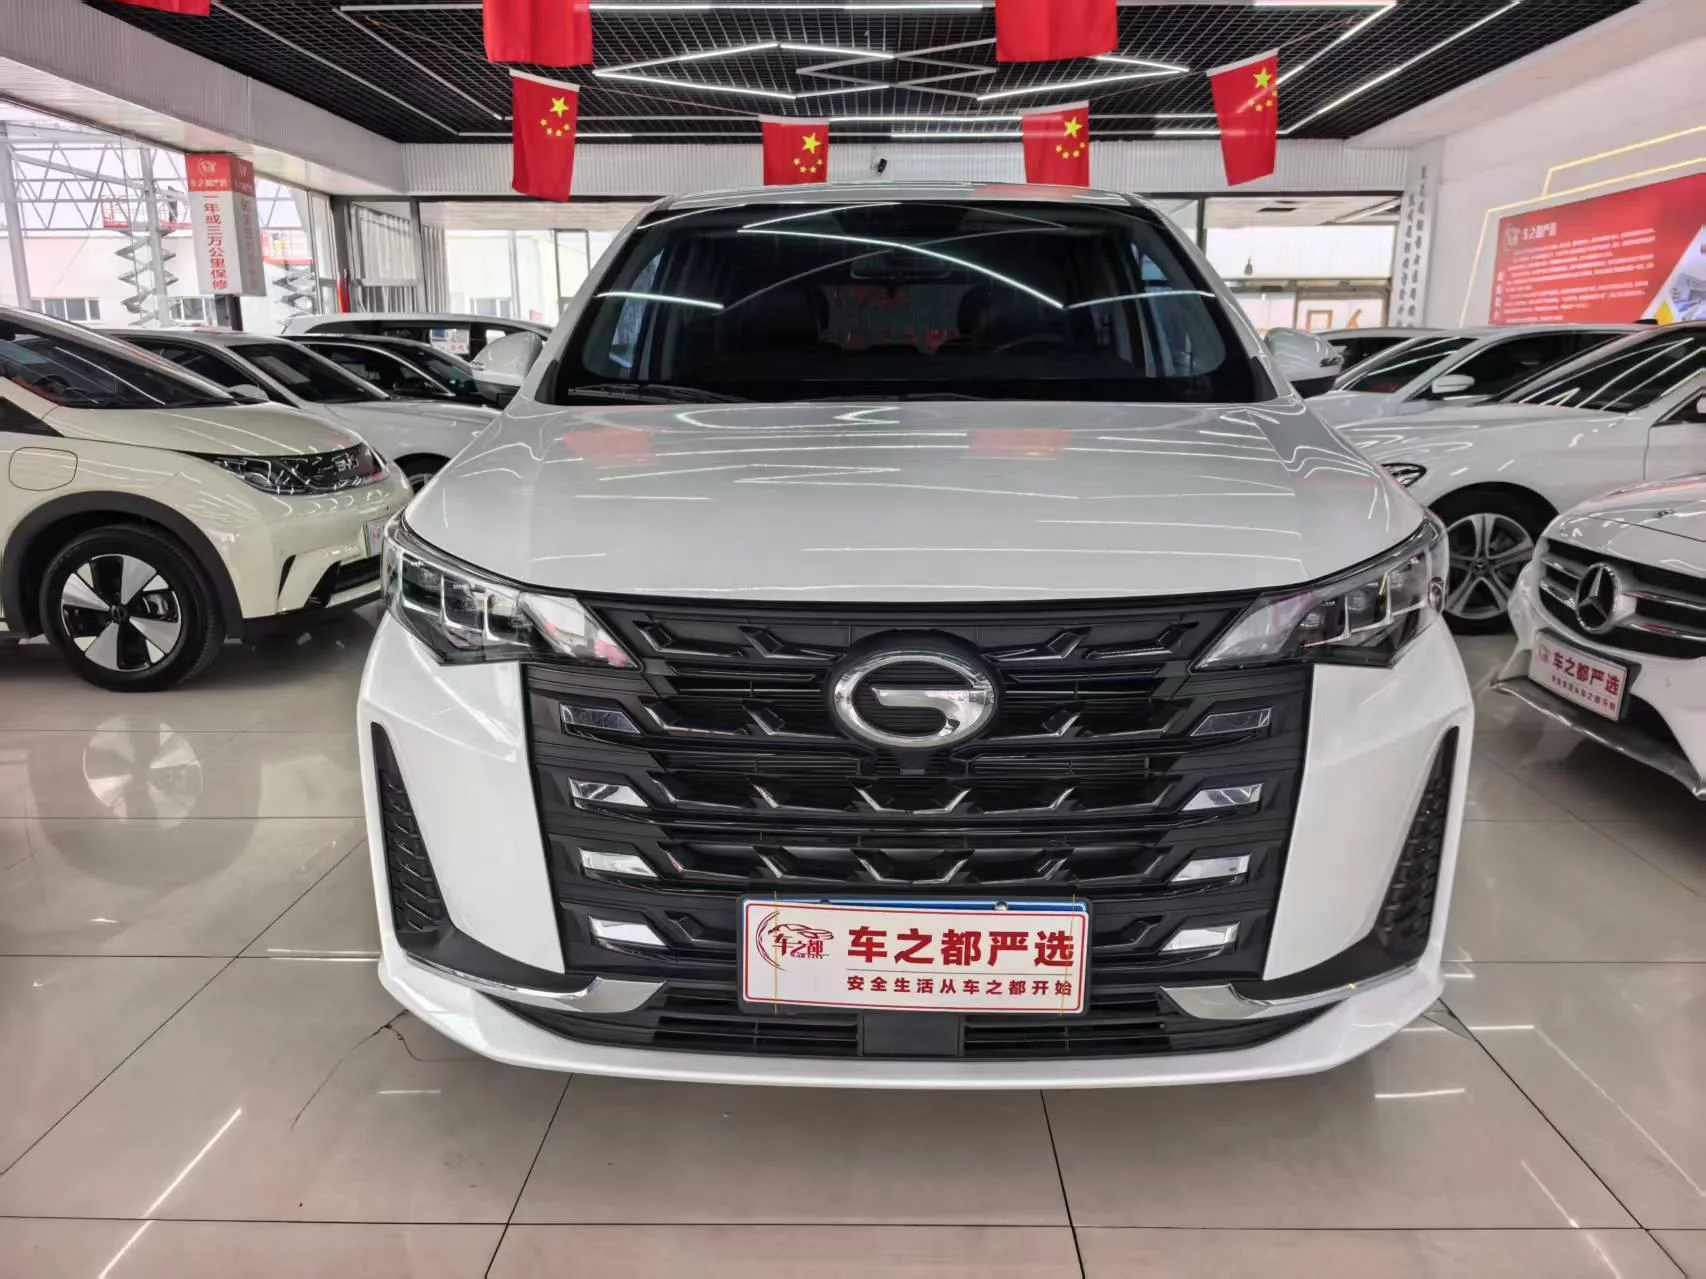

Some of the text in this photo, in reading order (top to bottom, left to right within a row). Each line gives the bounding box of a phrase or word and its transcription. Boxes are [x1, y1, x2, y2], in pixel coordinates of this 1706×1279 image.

[202, 195, 228, 289] 一年或三万公里保修
[1552, 652, 1620, 696] 车之都严选
[848, 926, 1074, 967] 车之都严选
[847, 975, 1073, 996] 安全生活从车之都开始
